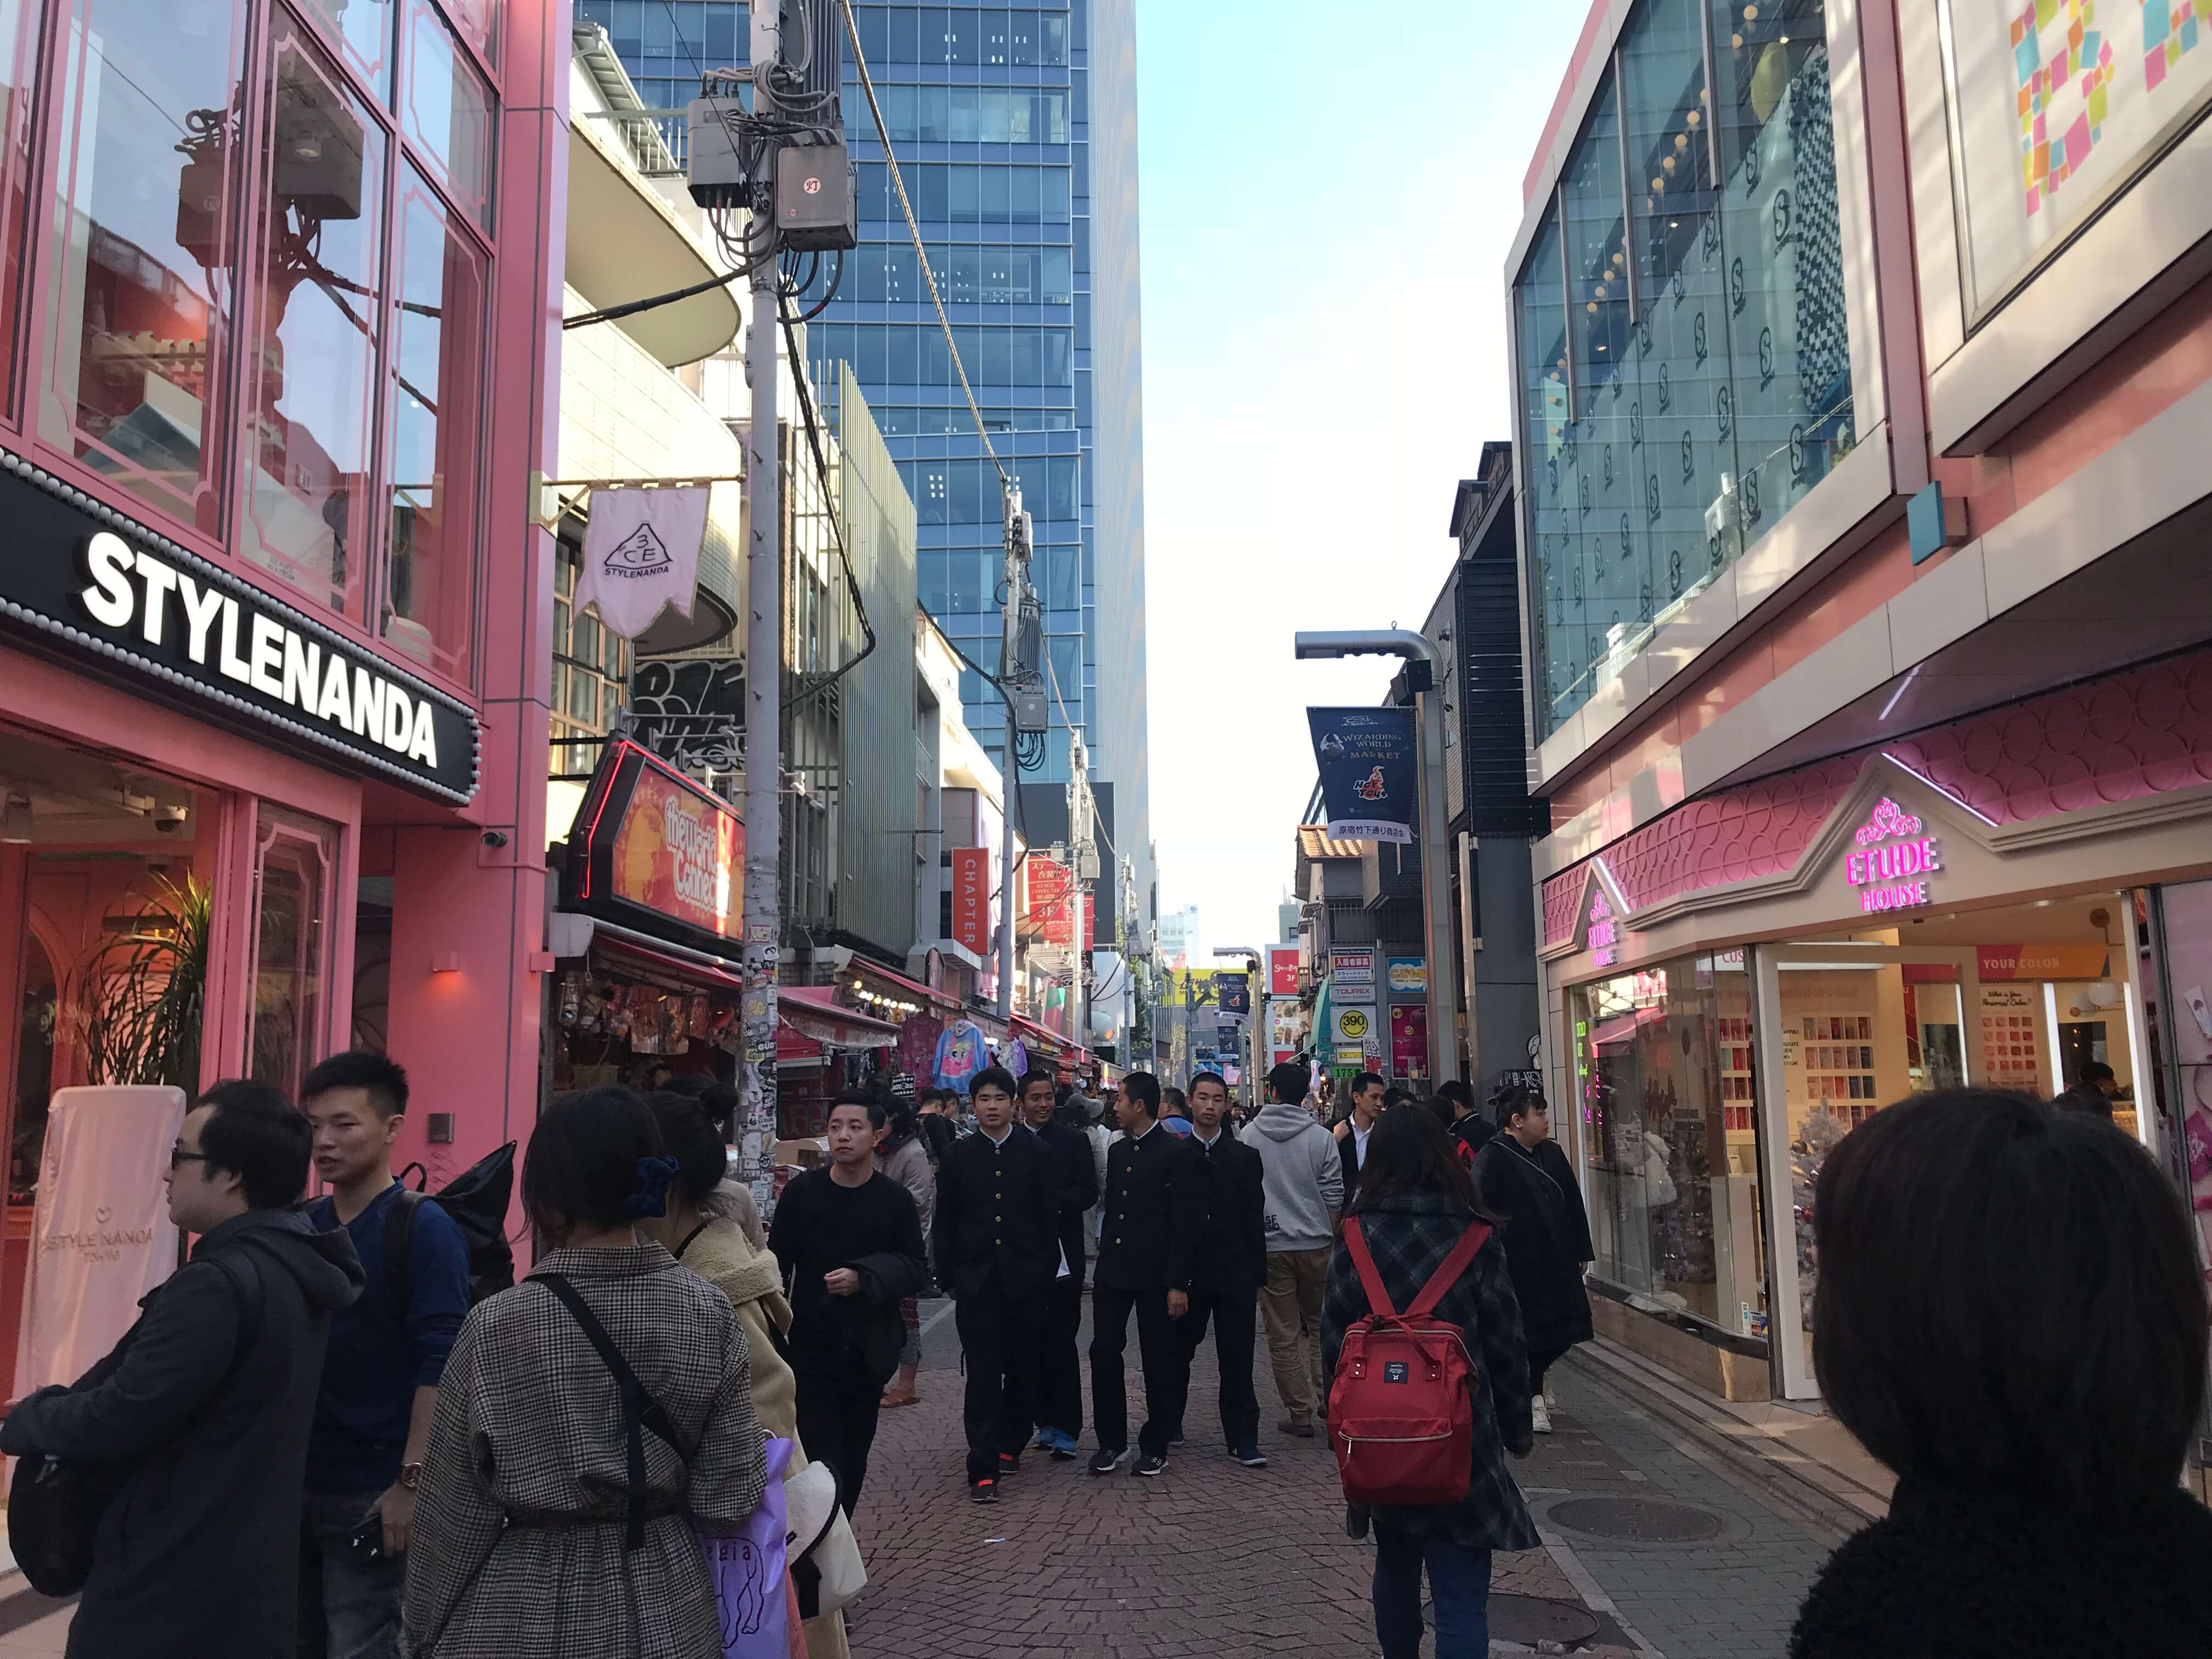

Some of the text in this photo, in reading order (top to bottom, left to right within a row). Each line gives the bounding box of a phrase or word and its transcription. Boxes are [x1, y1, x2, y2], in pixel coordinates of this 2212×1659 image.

[806, 180, 818, 191] 灯
[605, 566, 669, 578] STYLENANDA
[81, 532, 438, 769] STYLENANDA
[1344, 733, 1401, 742] WIZARDING
[1350, 751, 1401, 759] MARKET
[1339, 826, 1404, 837] 原宿竹下通り商店会
[1846, 837, 1940, 887] ETUDE
[965, 859, 976, 944] CHAPTER
[1861, 881, 1927, 913] HOUSE
[1983, 958, 2059, 969] YOUR COLOR
[1343, 1015, 1365, 1025] 390
